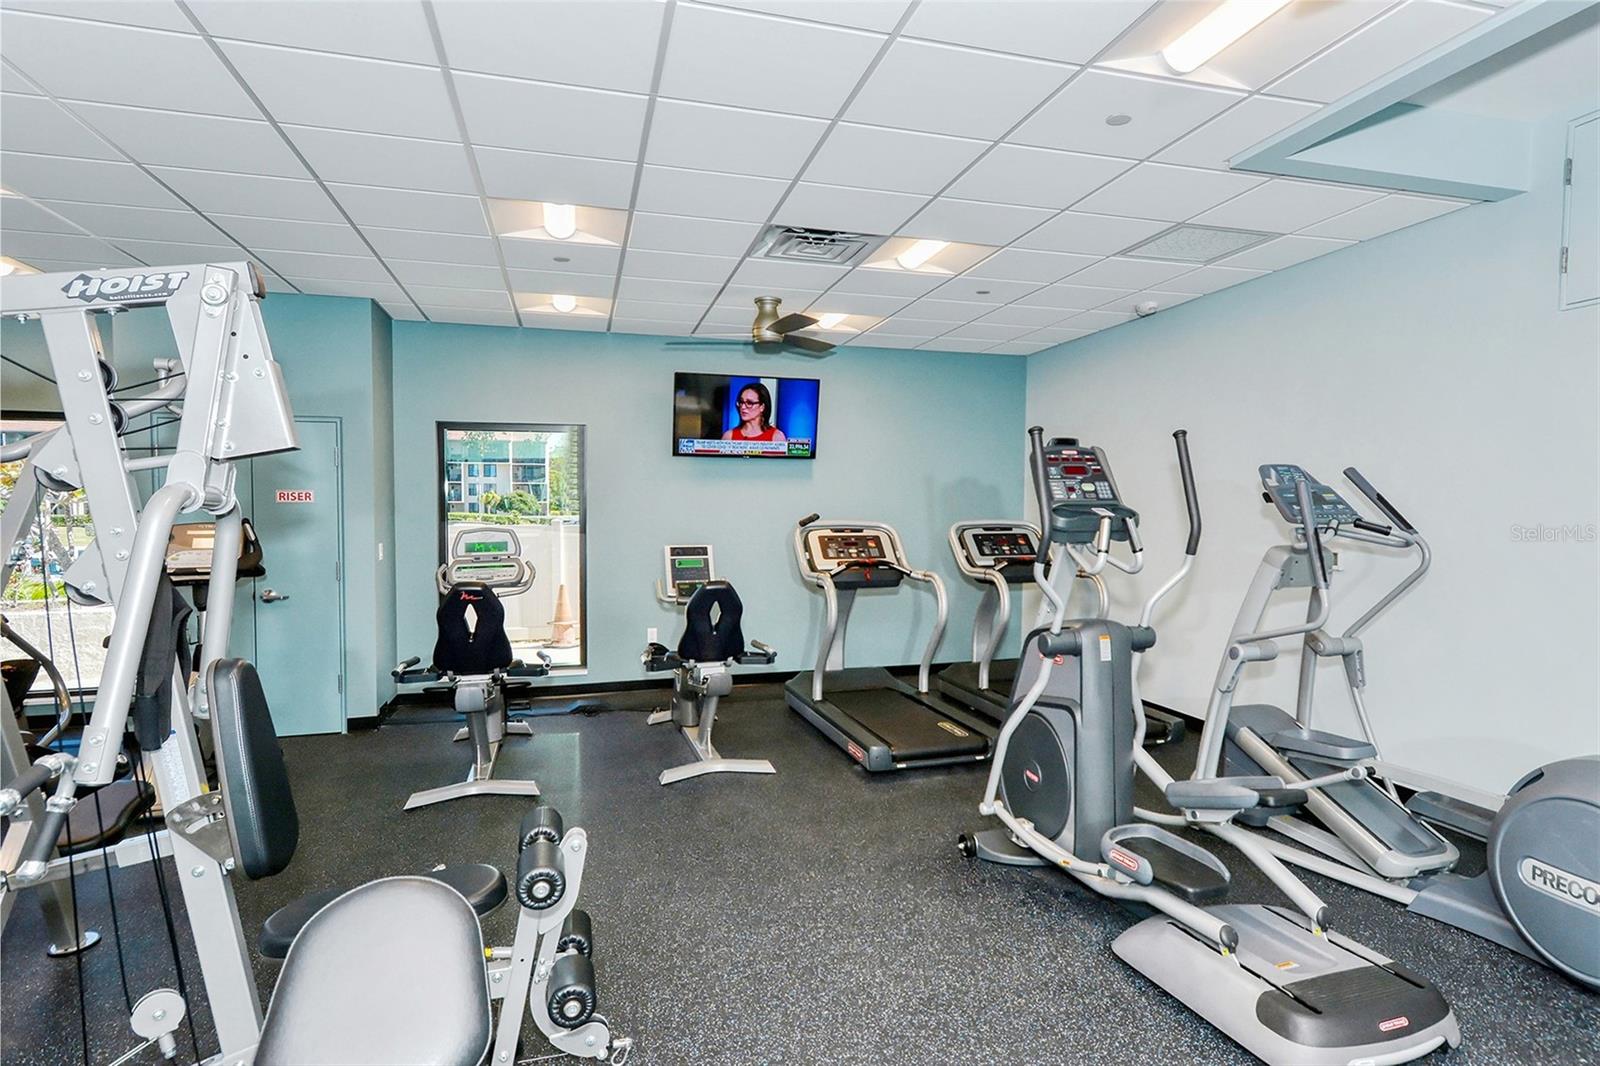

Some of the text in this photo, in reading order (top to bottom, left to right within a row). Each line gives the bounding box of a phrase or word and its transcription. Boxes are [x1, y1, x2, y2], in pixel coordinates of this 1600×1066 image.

[68, 271, 188, 297] HOIST
[278, 491, 312, 501] RISER
[1531, 865, 1600, 905] PRECO
